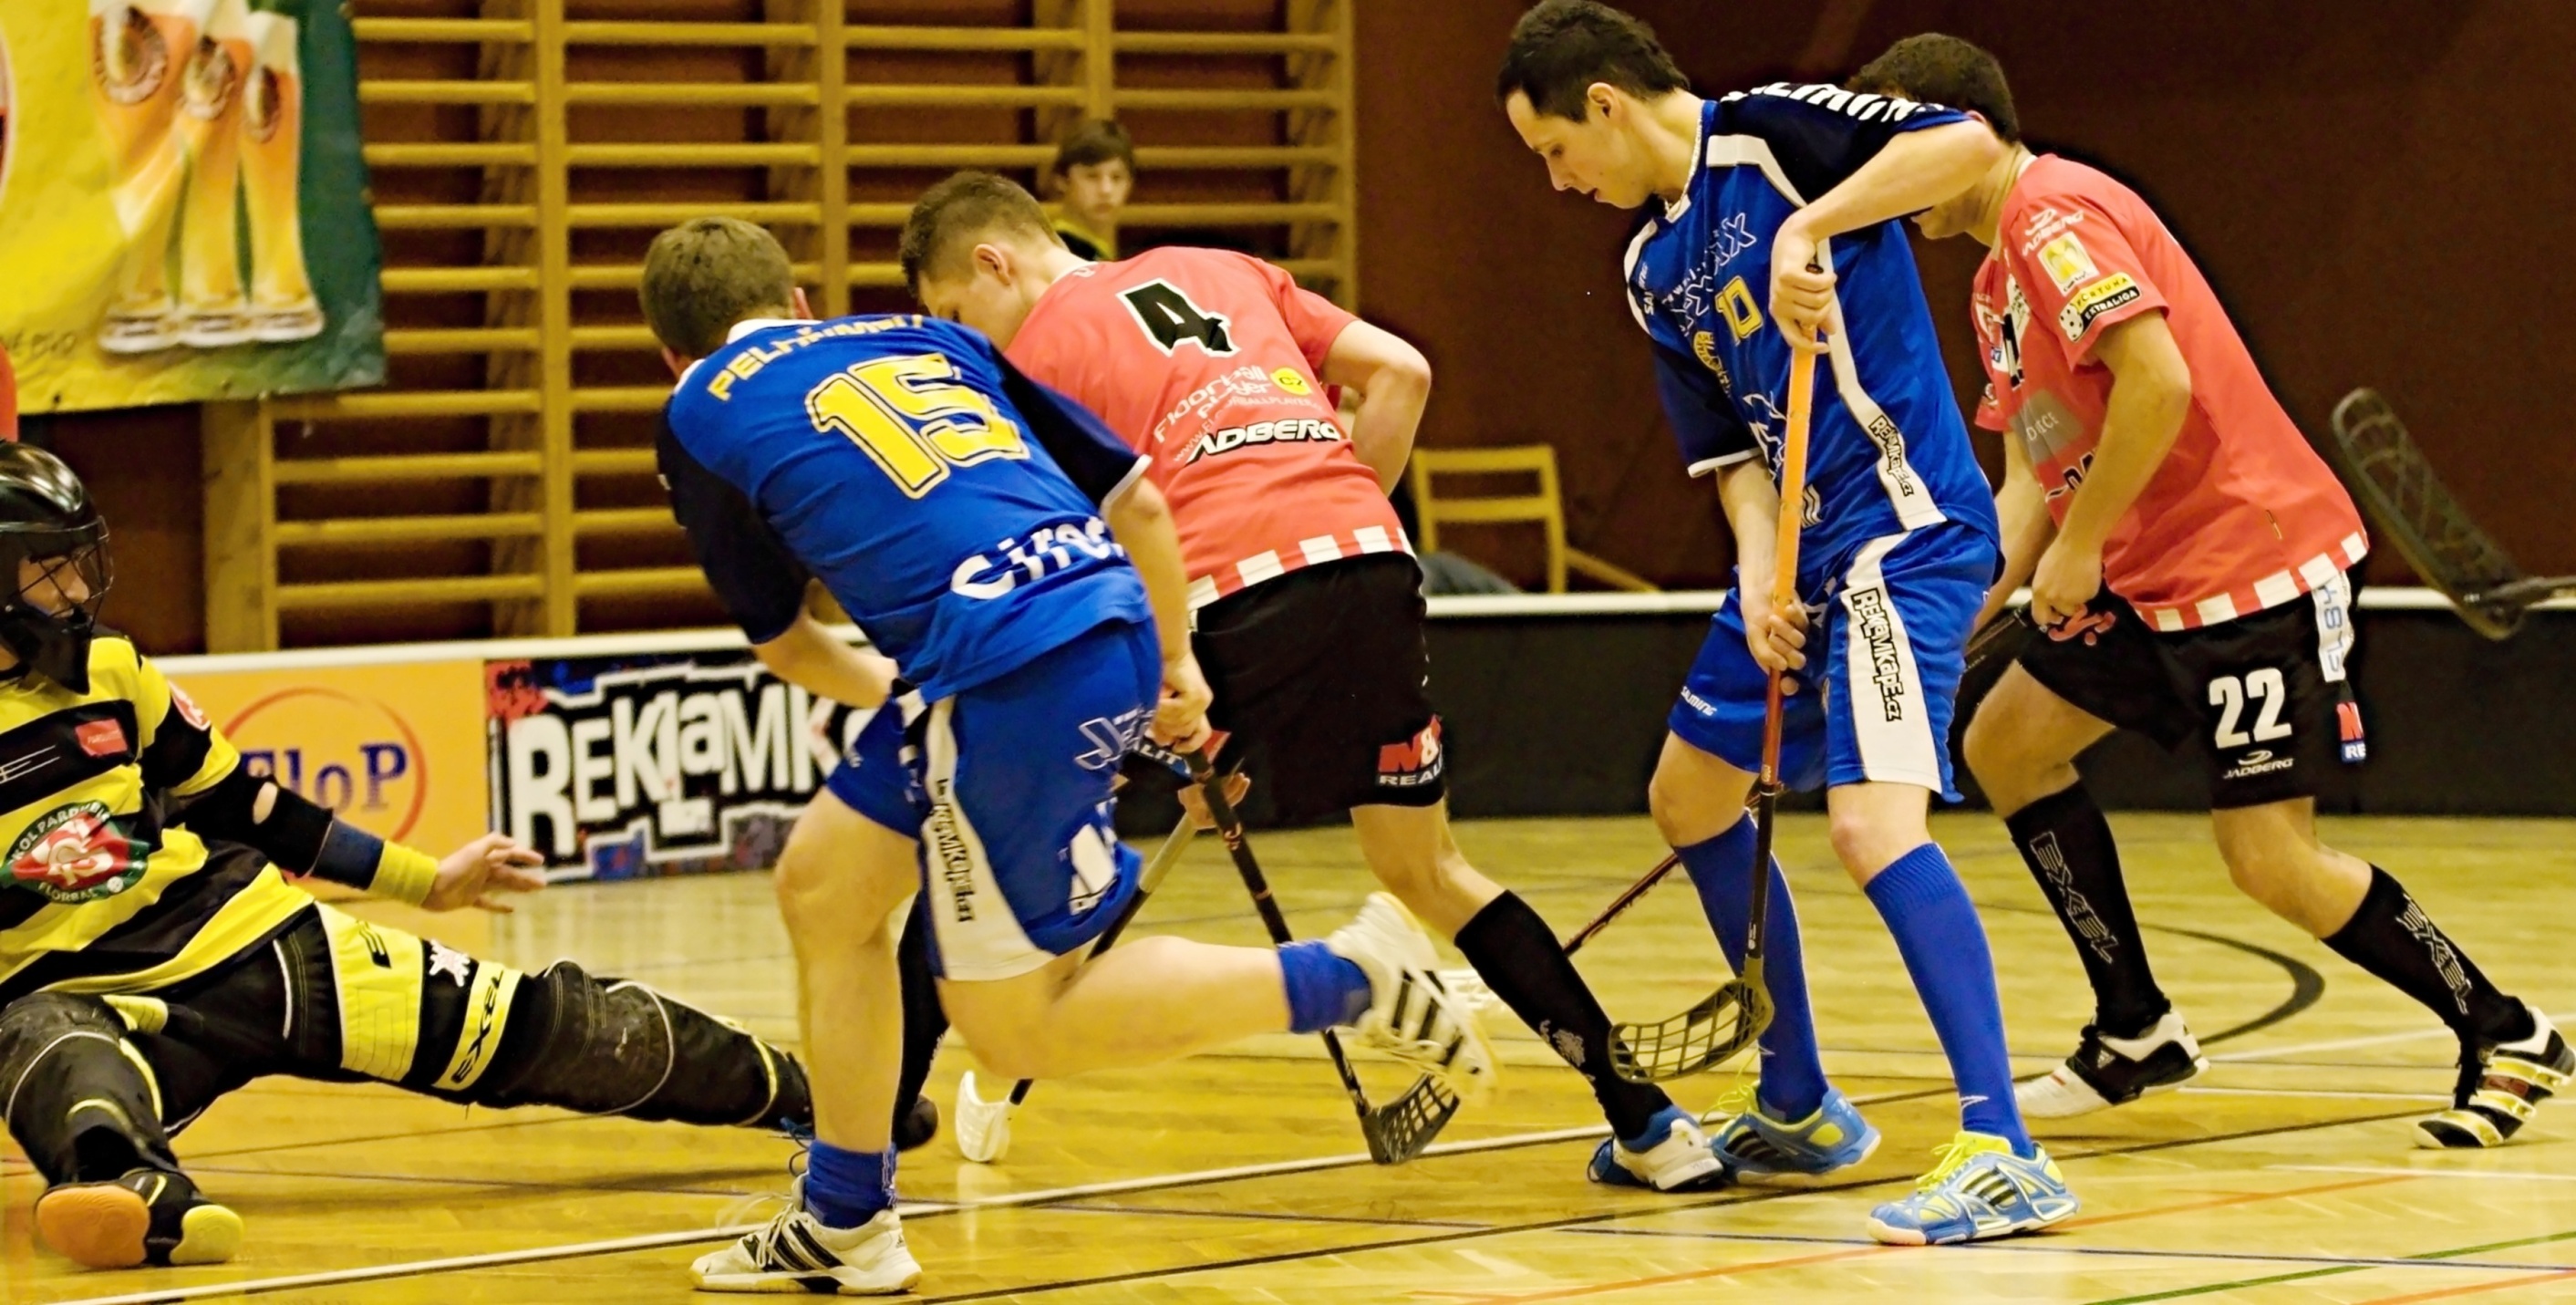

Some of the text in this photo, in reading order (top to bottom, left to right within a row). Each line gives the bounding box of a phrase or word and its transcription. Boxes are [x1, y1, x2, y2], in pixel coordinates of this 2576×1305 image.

[1116, 277, 1242, 357] 4
[1715, 275, 1763, 346] 10
[2084, 289, 2139, 320] EXTRALIGA
[805, 353, 1030, 500] 15
[2209, 667, 2292, 749] 22
[2030, 831, 2119, 964] EXEL
[2395, 893, 2472, 1015] EXEL
[450, 969, 504, 1084] EXEL
